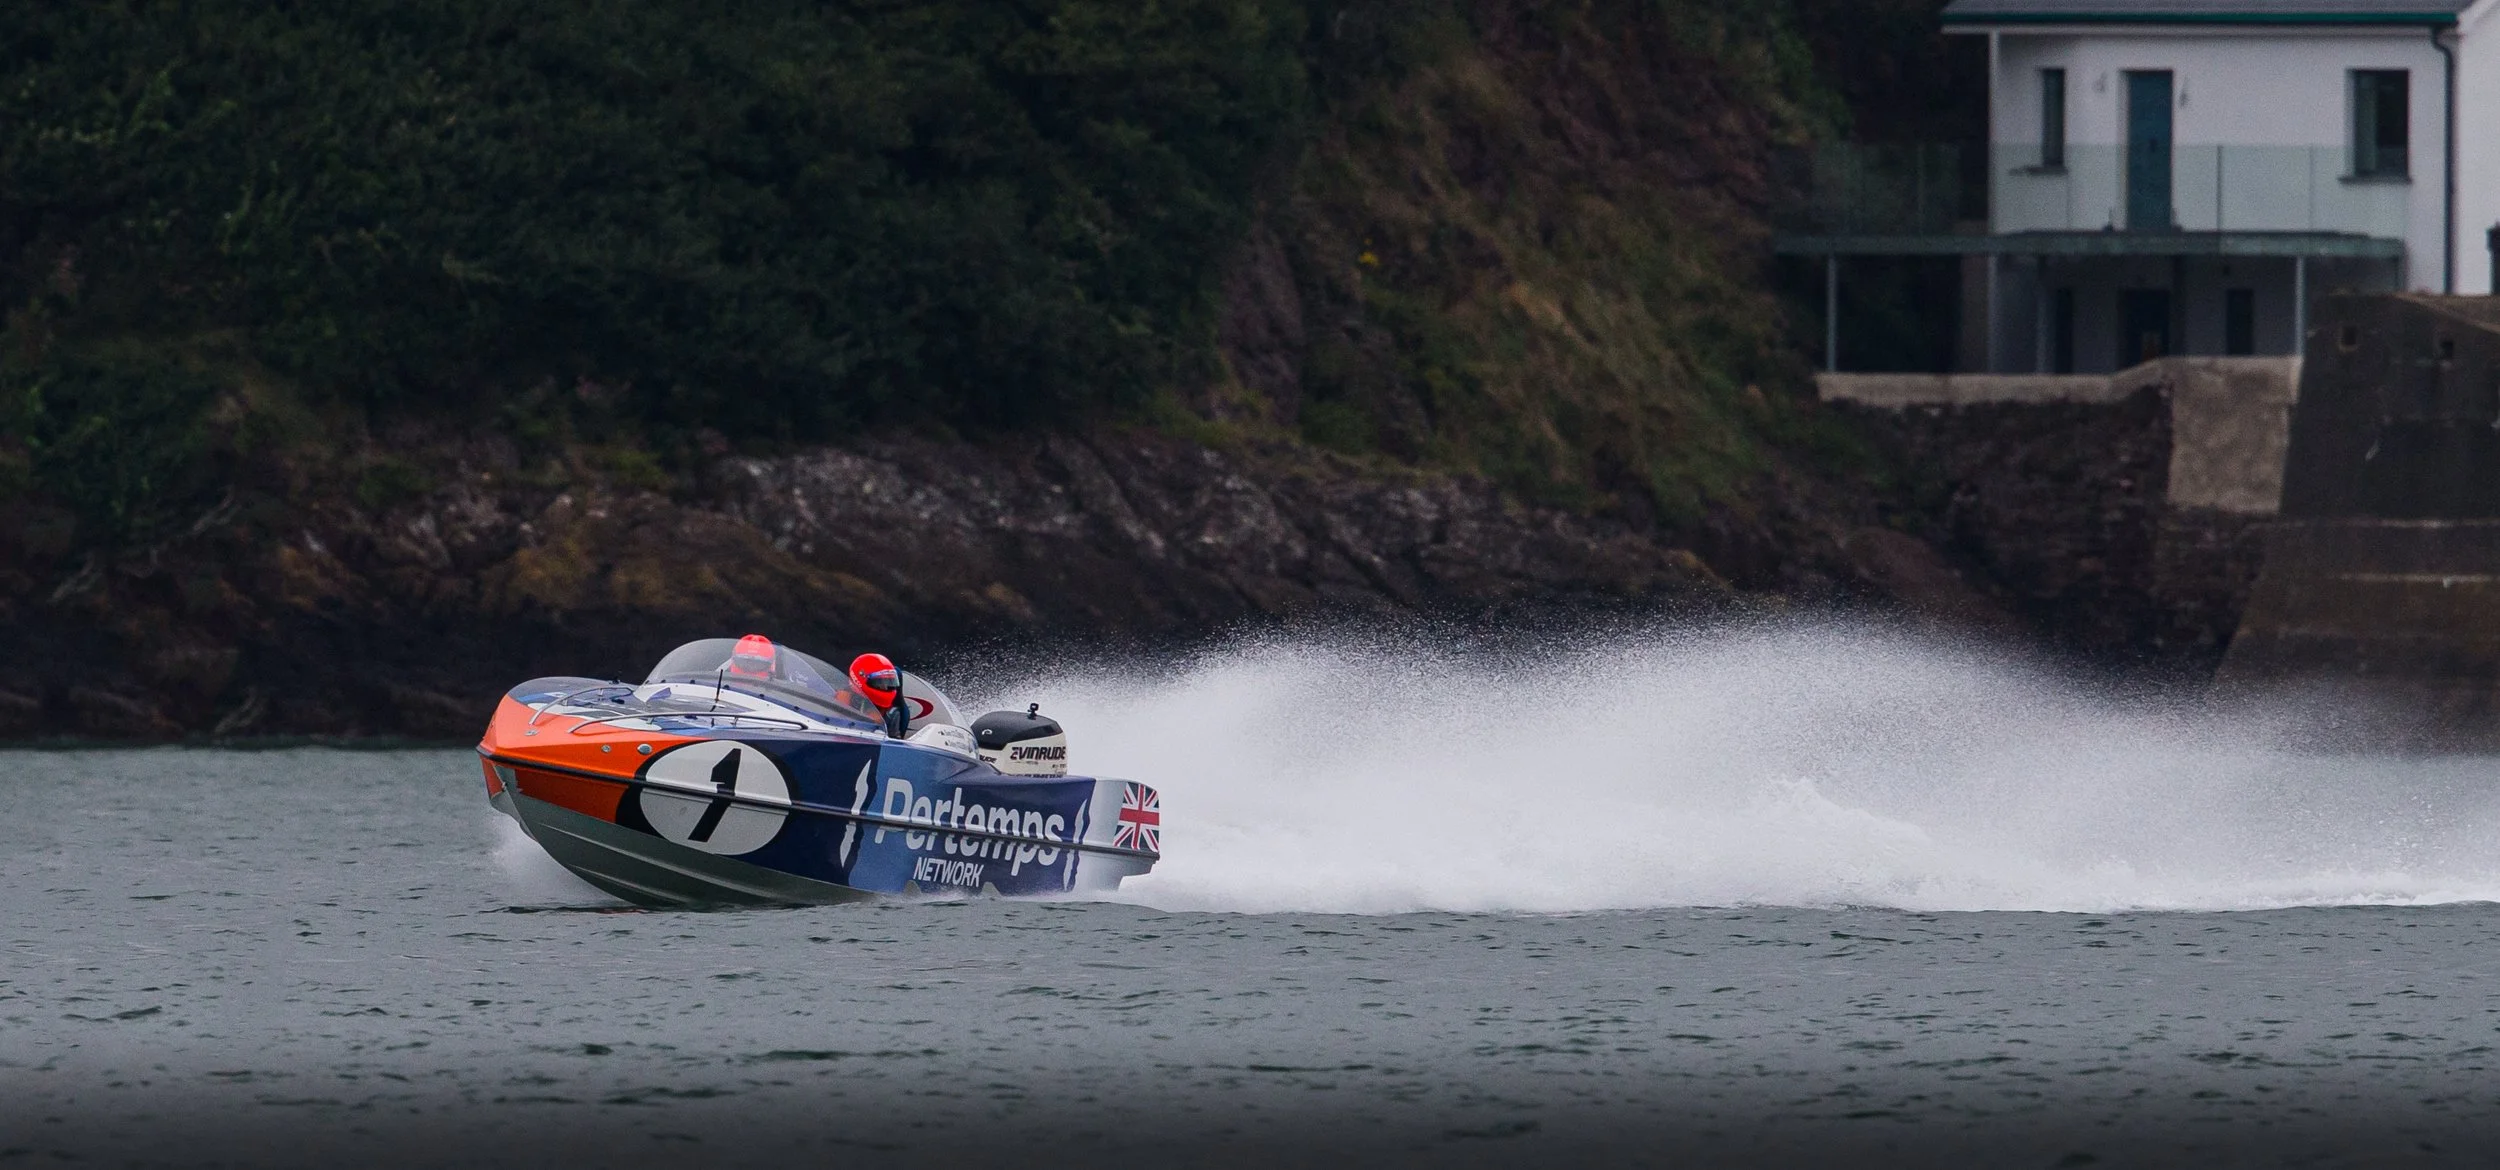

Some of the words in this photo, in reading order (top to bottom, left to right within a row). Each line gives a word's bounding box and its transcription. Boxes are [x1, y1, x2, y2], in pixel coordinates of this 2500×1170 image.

[1010, 746, 1066, 760] EVINRUDE
[687, 748, 742, 843] 1
[875, 778, 1065, 876] Pertemps
[913, 857, 984, 887] NETWORK
